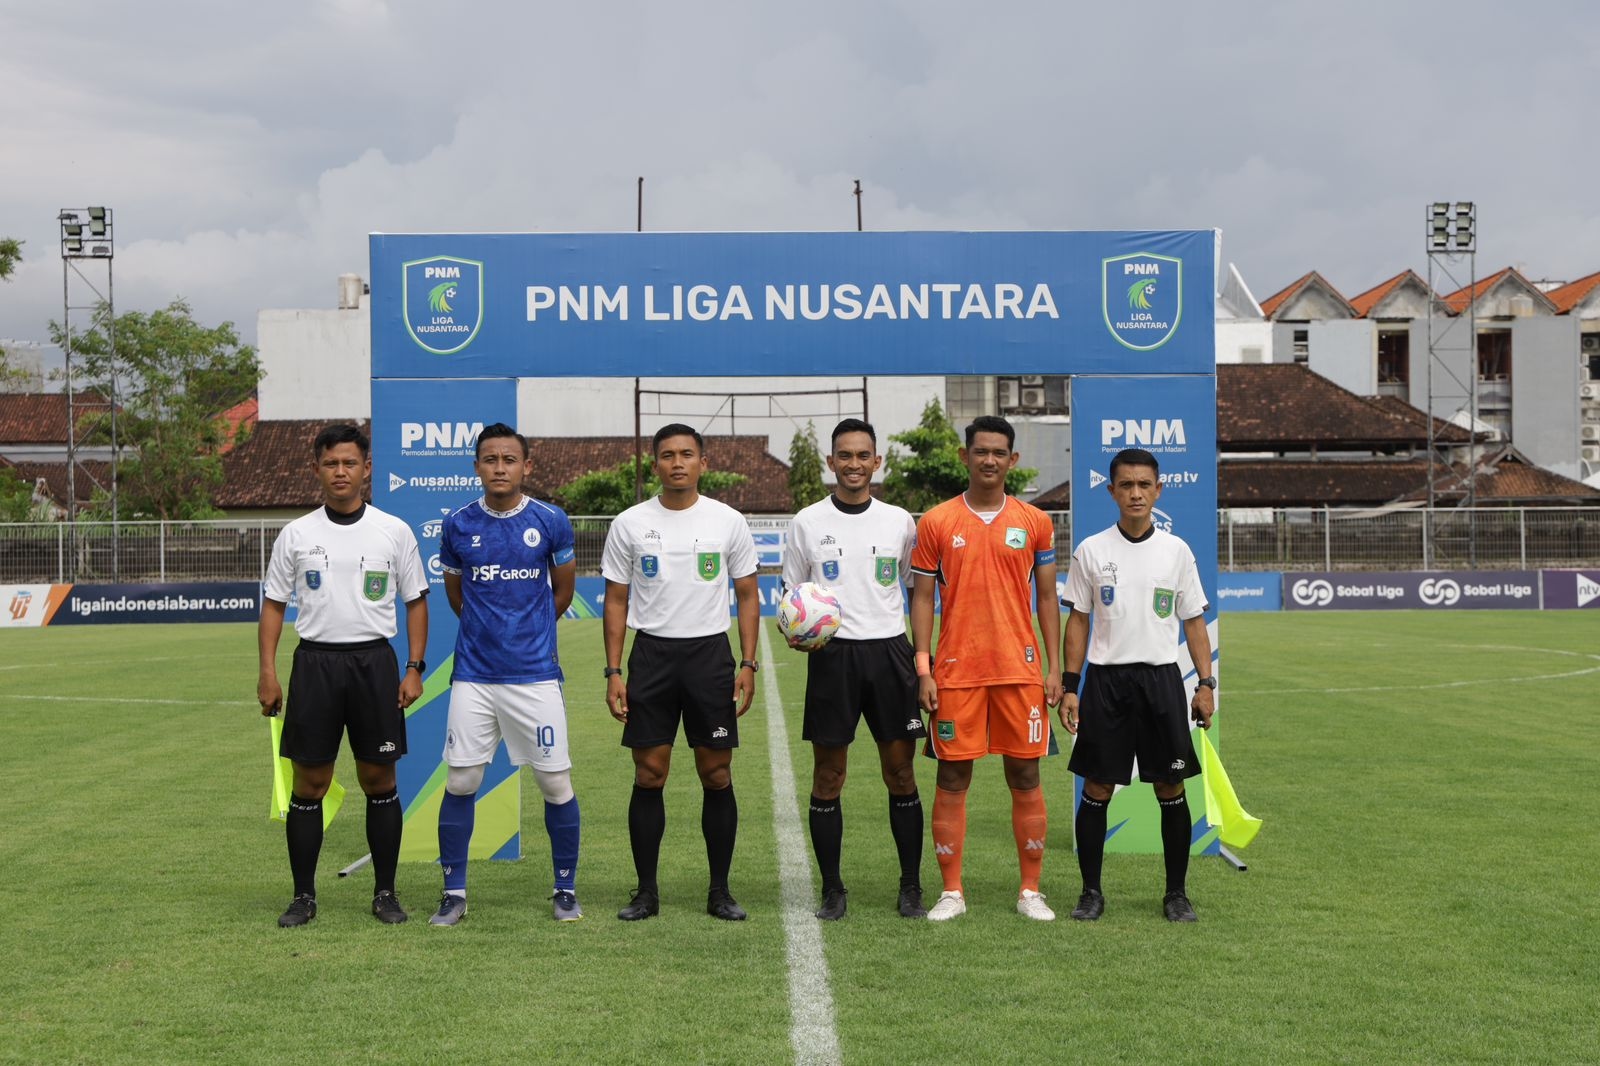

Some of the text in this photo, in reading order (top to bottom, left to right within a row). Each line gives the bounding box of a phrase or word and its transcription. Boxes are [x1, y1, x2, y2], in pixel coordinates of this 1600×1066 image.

[425, 267, 461, 278] PNM
[1124, 264, 1160, 275] PNM
[526, 283, 1059, 321] PNM LIGA NUSANTARA
[432, 317, 454, 325] LIGA
[1130, 313, 1152, 321] LIGA
[417, 325, 470, 334] NUSANTARA
[1116, 322, 1168, 330] NUSANTARA
[401, 422, 484, 448] PNM
[1102, 418, 1186, 446] PNM
[410, 474, 484, 486] nusantara
[1184, 471, 1198, 483] tv
[422, 525, 444, 538] SP
[1336, 584, 1404, 600] Sobat Liga
[1464, 584, 1532, 598] Sobat Liga
[71, 596, 254, 616] ligaindonesiabaru.com
[536, 726, 554, 747] 10
[1028, 719, 1042, 744] 10
